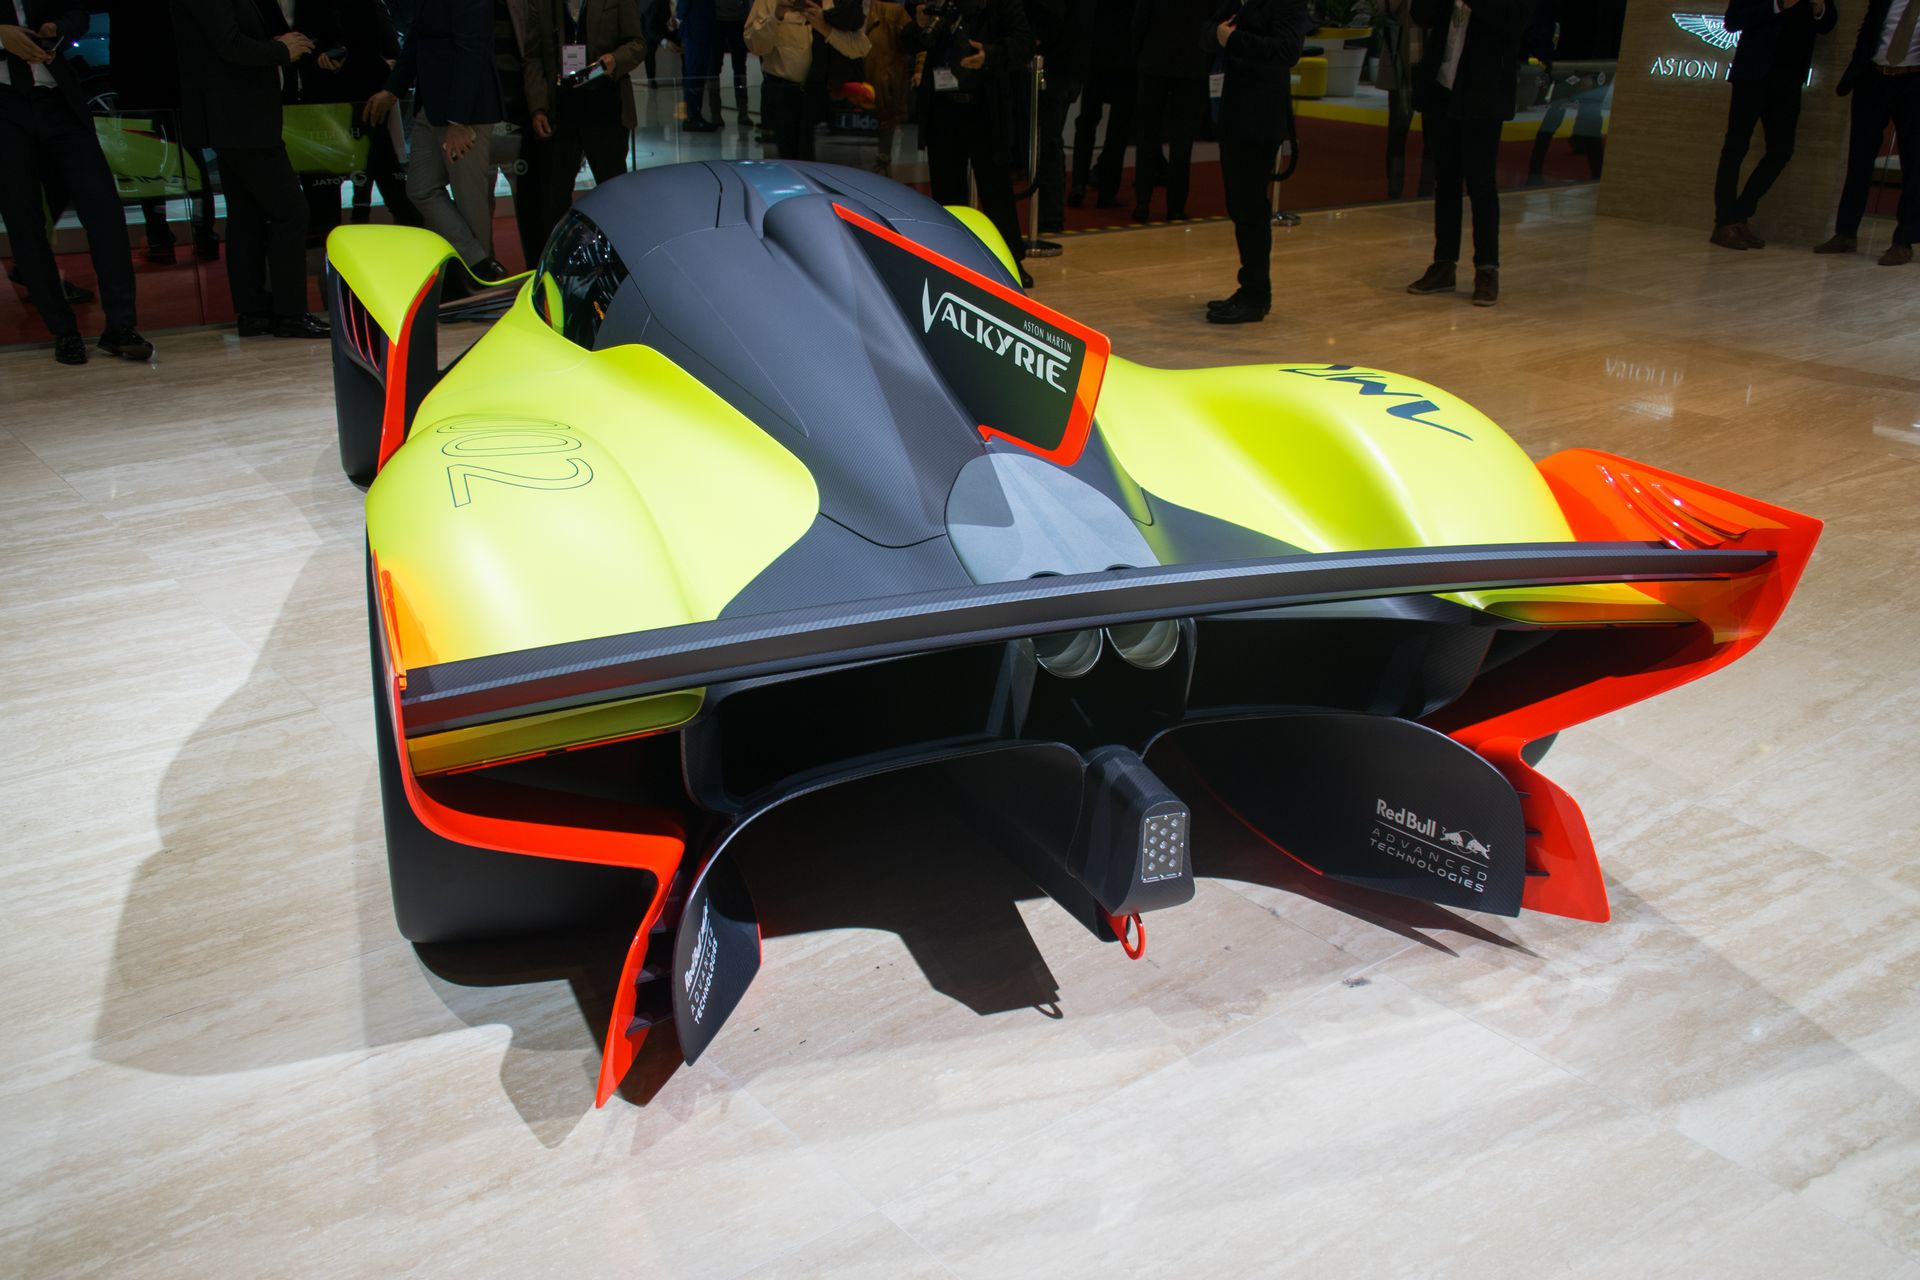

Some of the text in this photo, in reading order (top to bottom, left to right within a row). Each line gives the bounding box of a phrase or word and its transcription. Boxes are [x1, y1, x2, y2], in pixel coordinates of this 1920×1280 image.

[1650, 56, 1718, 81] ASTON
[922, 277, 1071, 393] VALKYRIE
[1023, 320, 1073, 353] ASTON MARTIN
[1369, 837, 1485, 894] TECHNOLOGIES
[1372, 827, 1488, 882] ADVANCED
